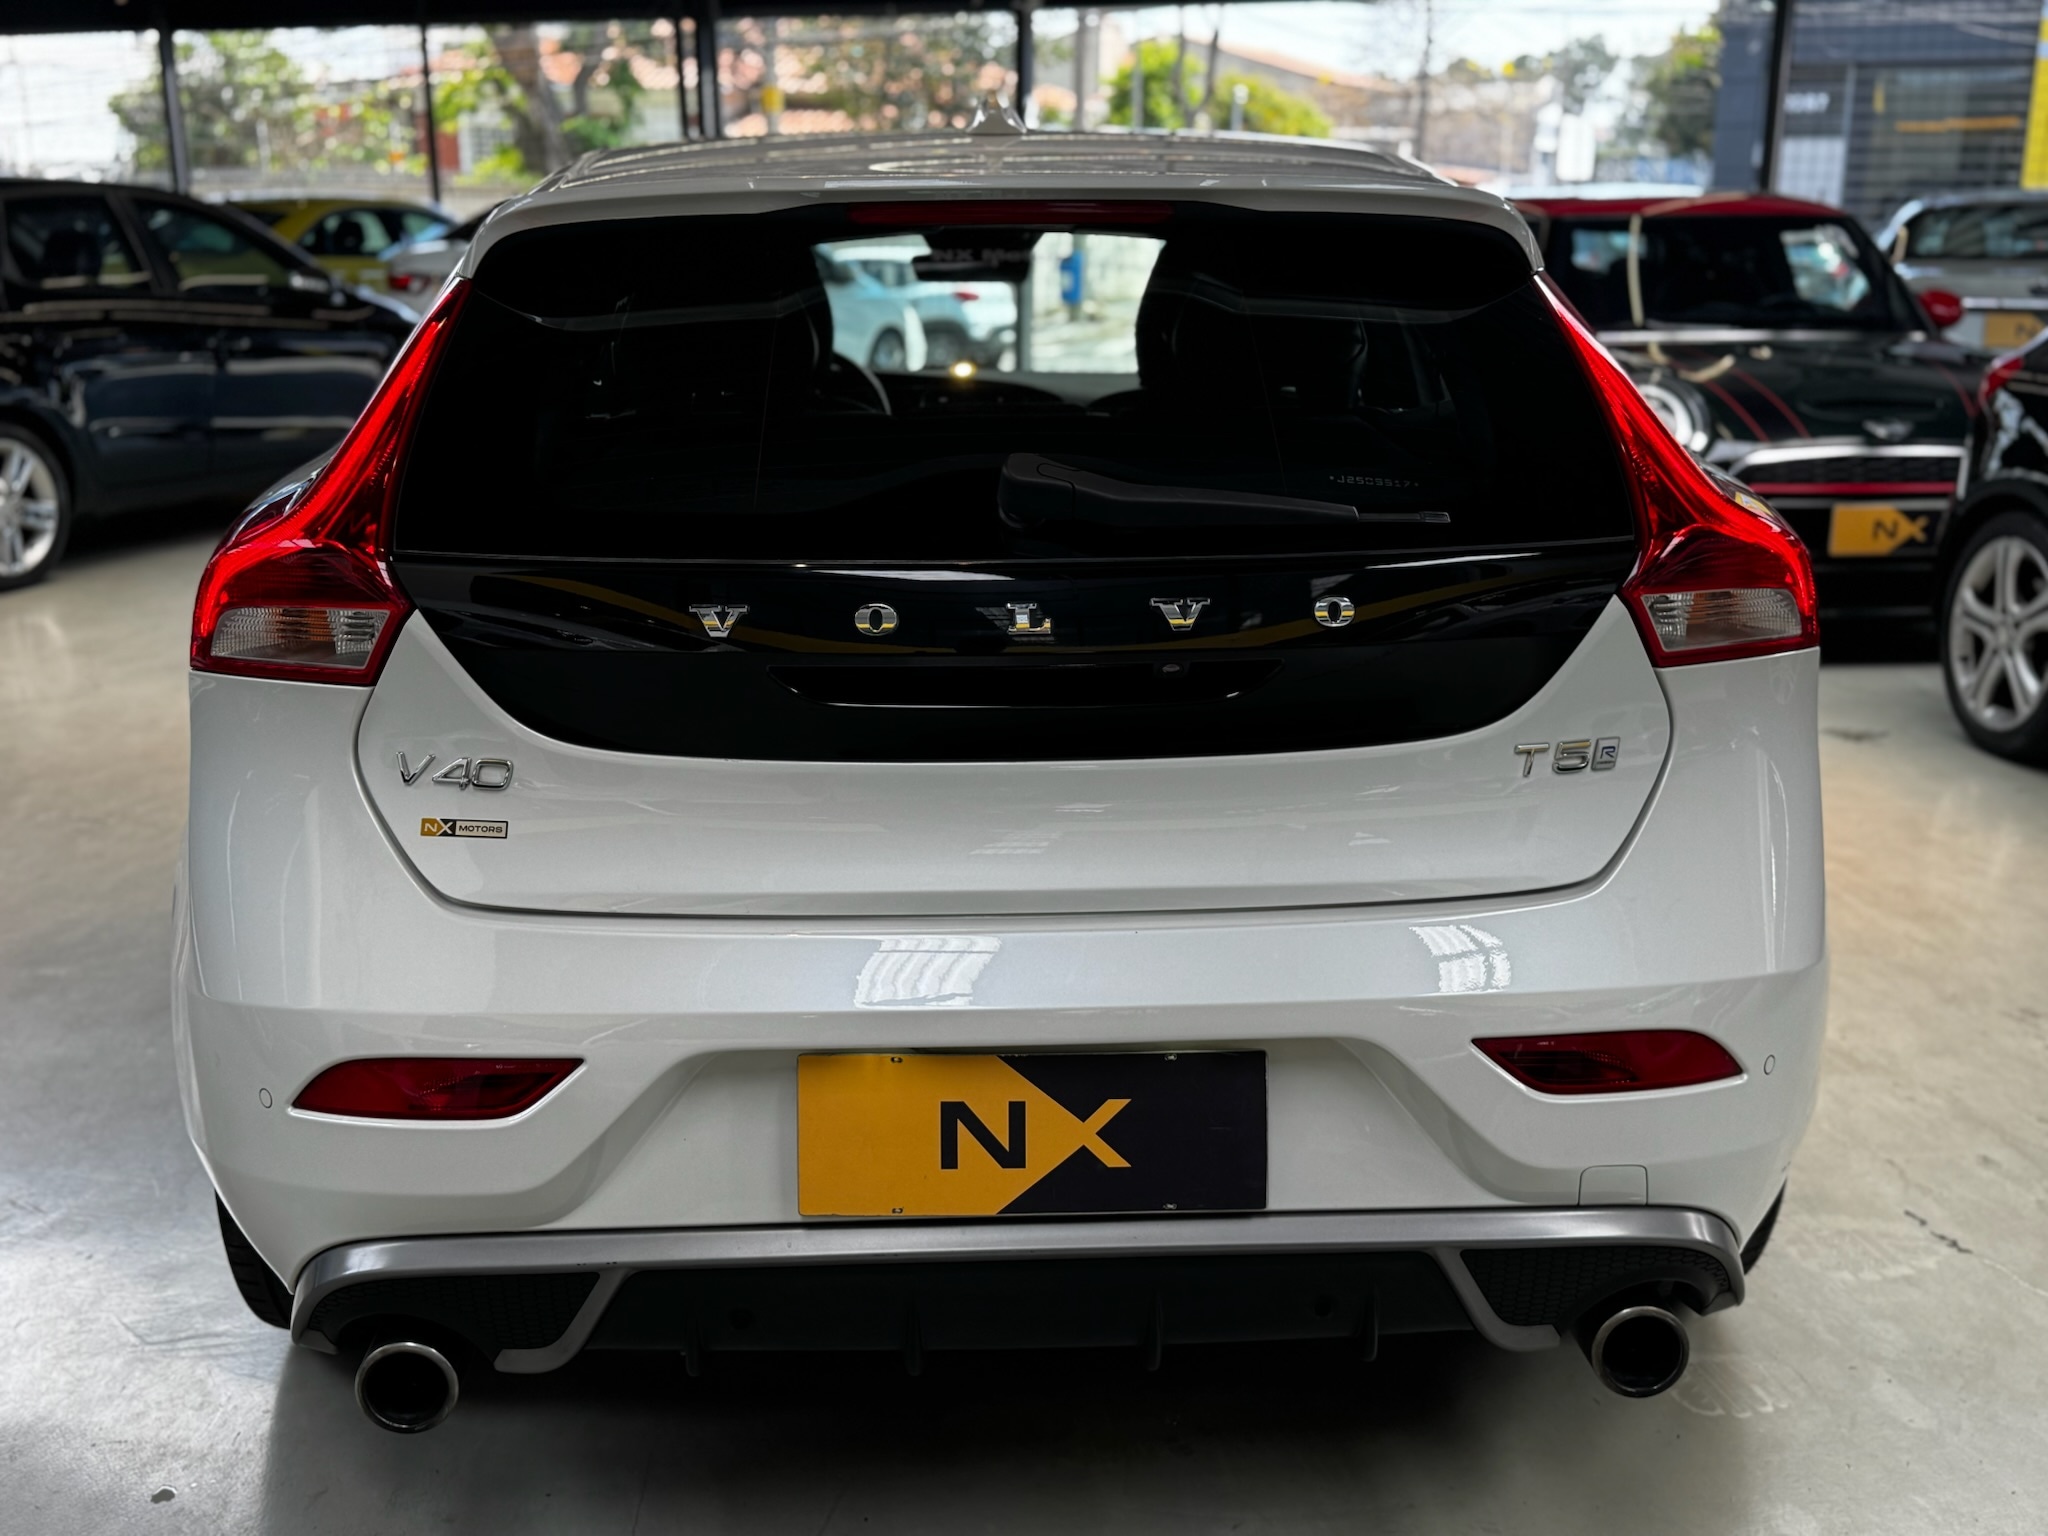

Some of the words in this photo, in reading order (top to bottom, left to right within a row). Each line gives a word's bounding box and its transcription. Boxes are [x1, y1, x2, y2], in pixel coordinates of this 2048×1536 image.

[1873, 515, 1929, 543] NX
[690, 595, 1355, 637] VOLVO
[395, 751, 513, 791] V40
[424, 820, 453, 836] NX
[458, 824, 503, 834] MOTORS
[938, 1099, 1131, 1170] NX
